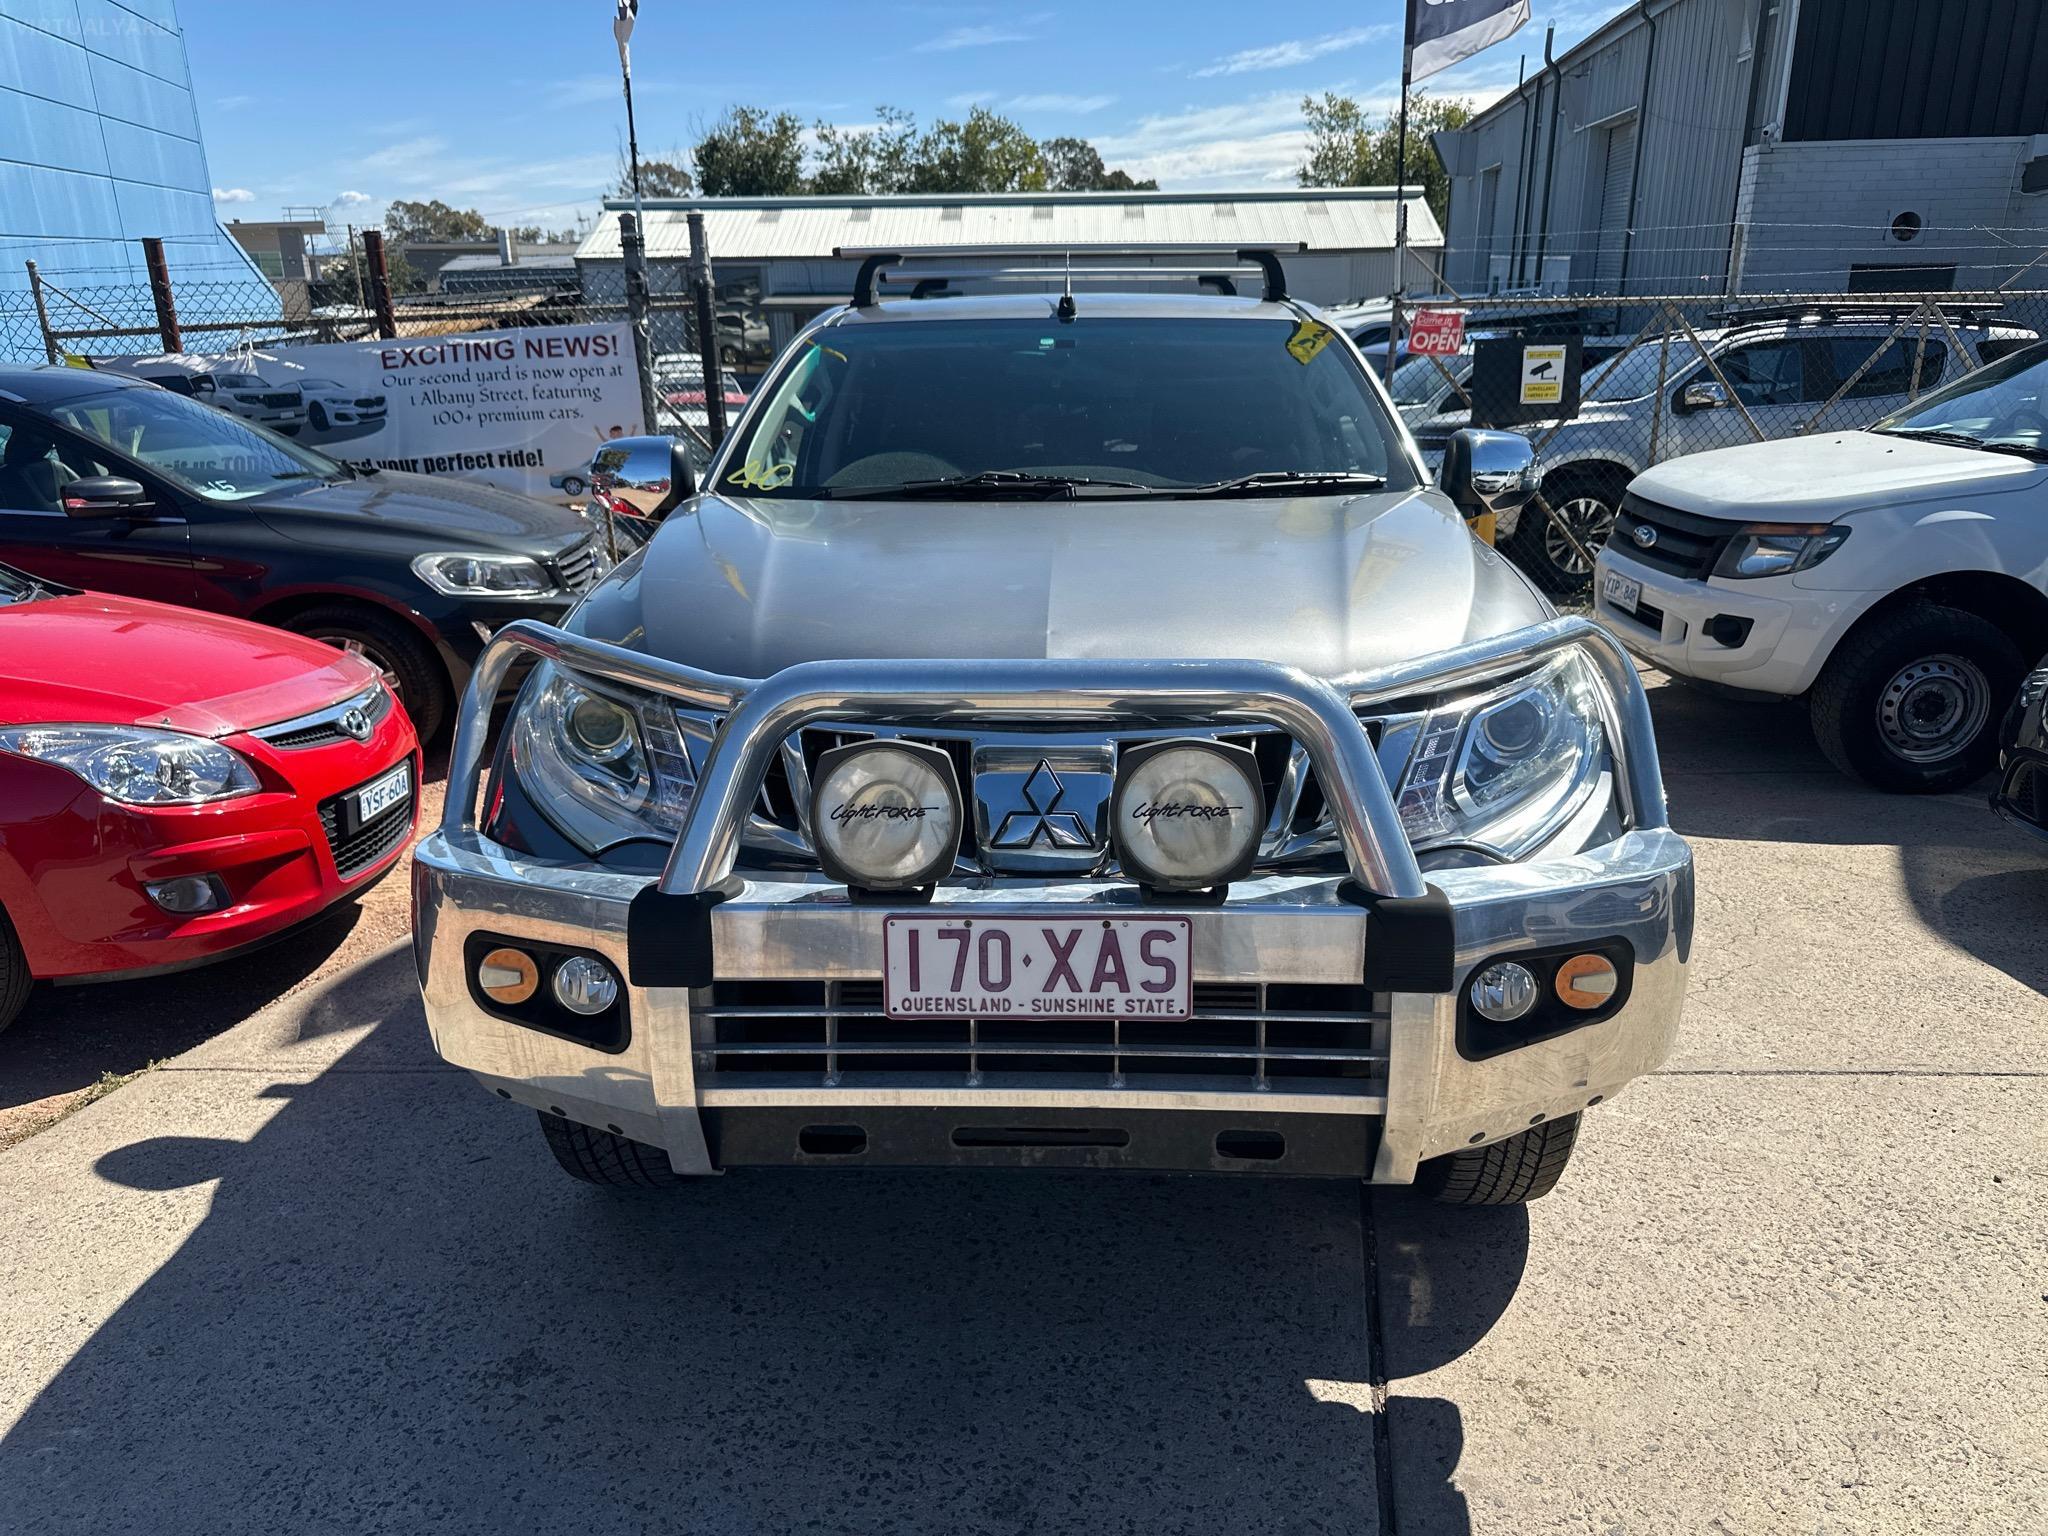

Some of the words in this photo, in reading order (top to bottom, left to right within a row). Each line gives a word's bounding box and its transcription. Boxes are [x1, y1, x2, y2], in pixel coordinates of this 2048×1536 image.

[381, 339, 515, 370] EXCITING
[525, 335, 618, 359] NEWS!
[1412, 331, 1460, 351] OPEN
[382, 373, 415, 388] Our
[419, 368, 471, 385] second
[476, 365, 512, 387] yard
[516, 364, 528, 380] is
[533, 367, 565, 380] now
[569, 366, 604, 384] open
[609, 364, 623, 377] at
[421, 390, 475, 409] Albany
[480, 388, 528, 404] Street,
[532, 383, 602, 402] featuring
[433, 410, 473, 427] 100+
[478, 406, 545, 428] premium
[549, 407, 584, 420] cars.
[423, 451, 495, 475] perfect
[498, 449, 544, 468] ride!
[908, 928, 1012, 993] 170
[1041, 928, 1178, 993] XAS
[901, 996, 1012, 1013] QUEENSLAND
[1031, 997, 1115, 1013] SUNSHINE
[1125, 998, 1175, 1014] STATE
